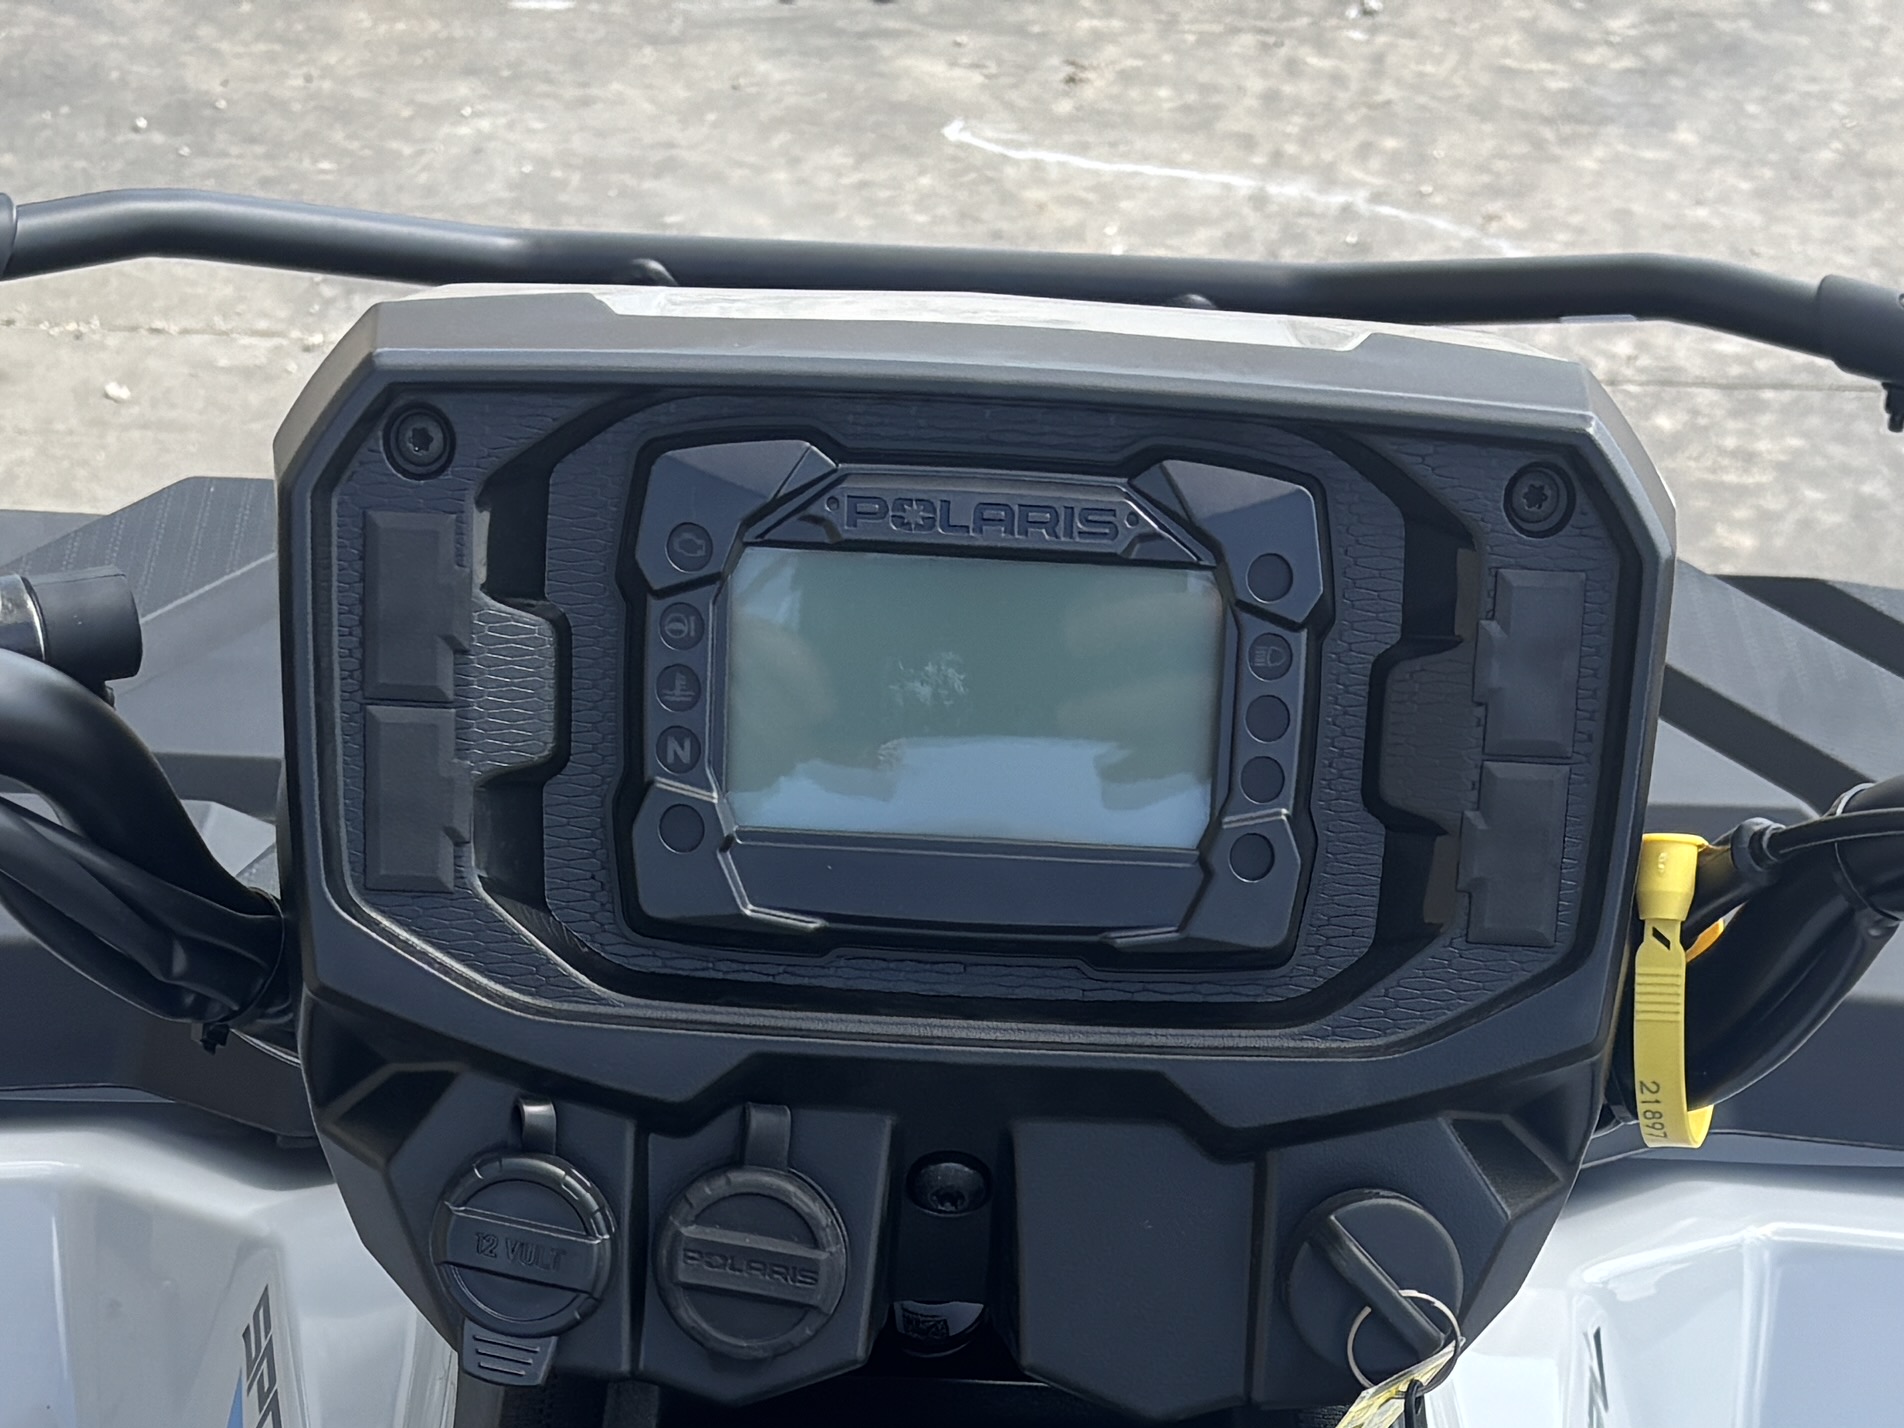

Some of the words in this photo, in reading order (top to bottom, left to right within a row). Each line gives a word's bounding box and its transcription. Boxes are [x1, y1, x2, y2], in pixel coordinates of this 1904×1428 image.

[844, 493, 1119, 541] POLARIS
[1639, 1080, 1668, 1139] 21897
[682, 1249, 818, 1287] POLARIS
